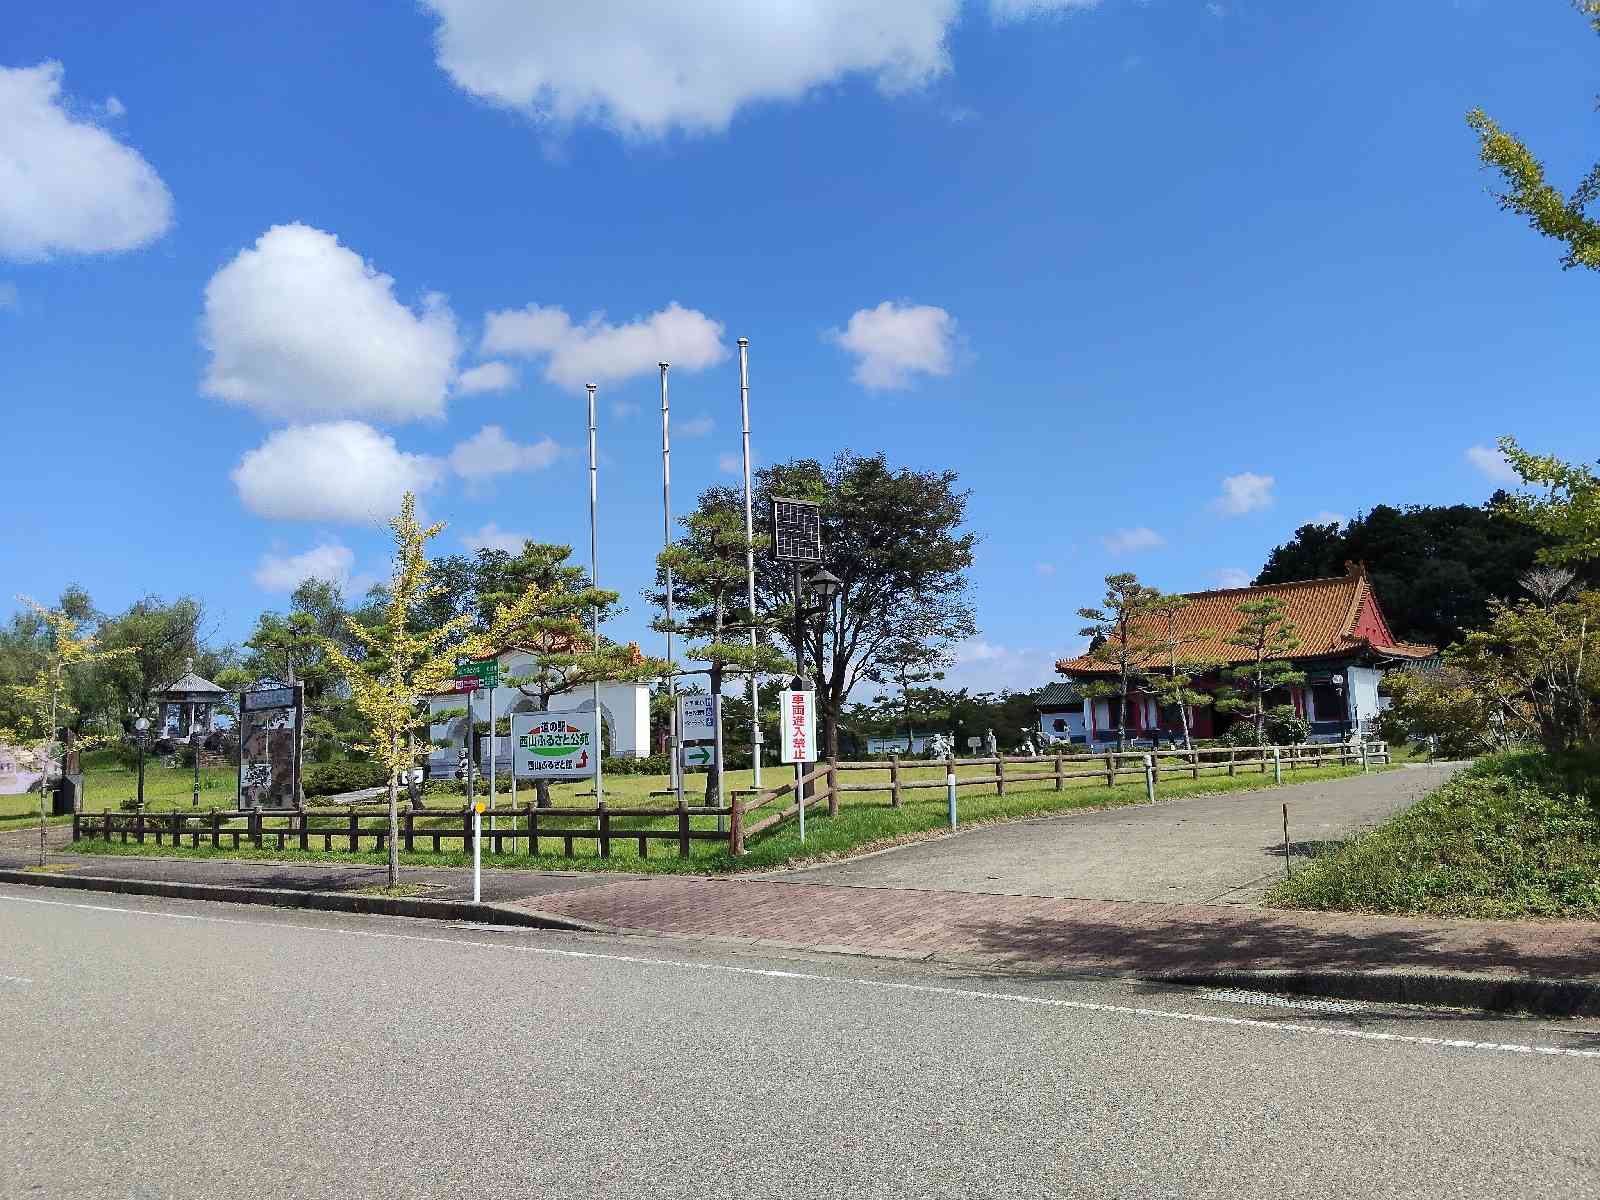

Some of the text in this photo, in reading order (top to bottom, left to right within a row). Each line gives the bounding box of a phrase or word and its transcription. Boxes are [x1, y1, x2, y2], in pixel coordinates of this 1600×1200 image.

[541, 721, 566, 733] 道の駅
[792, 694, 806, 760] 車両進入禁止
[519, 732, 590, 748] 西山ふるさと公苑
